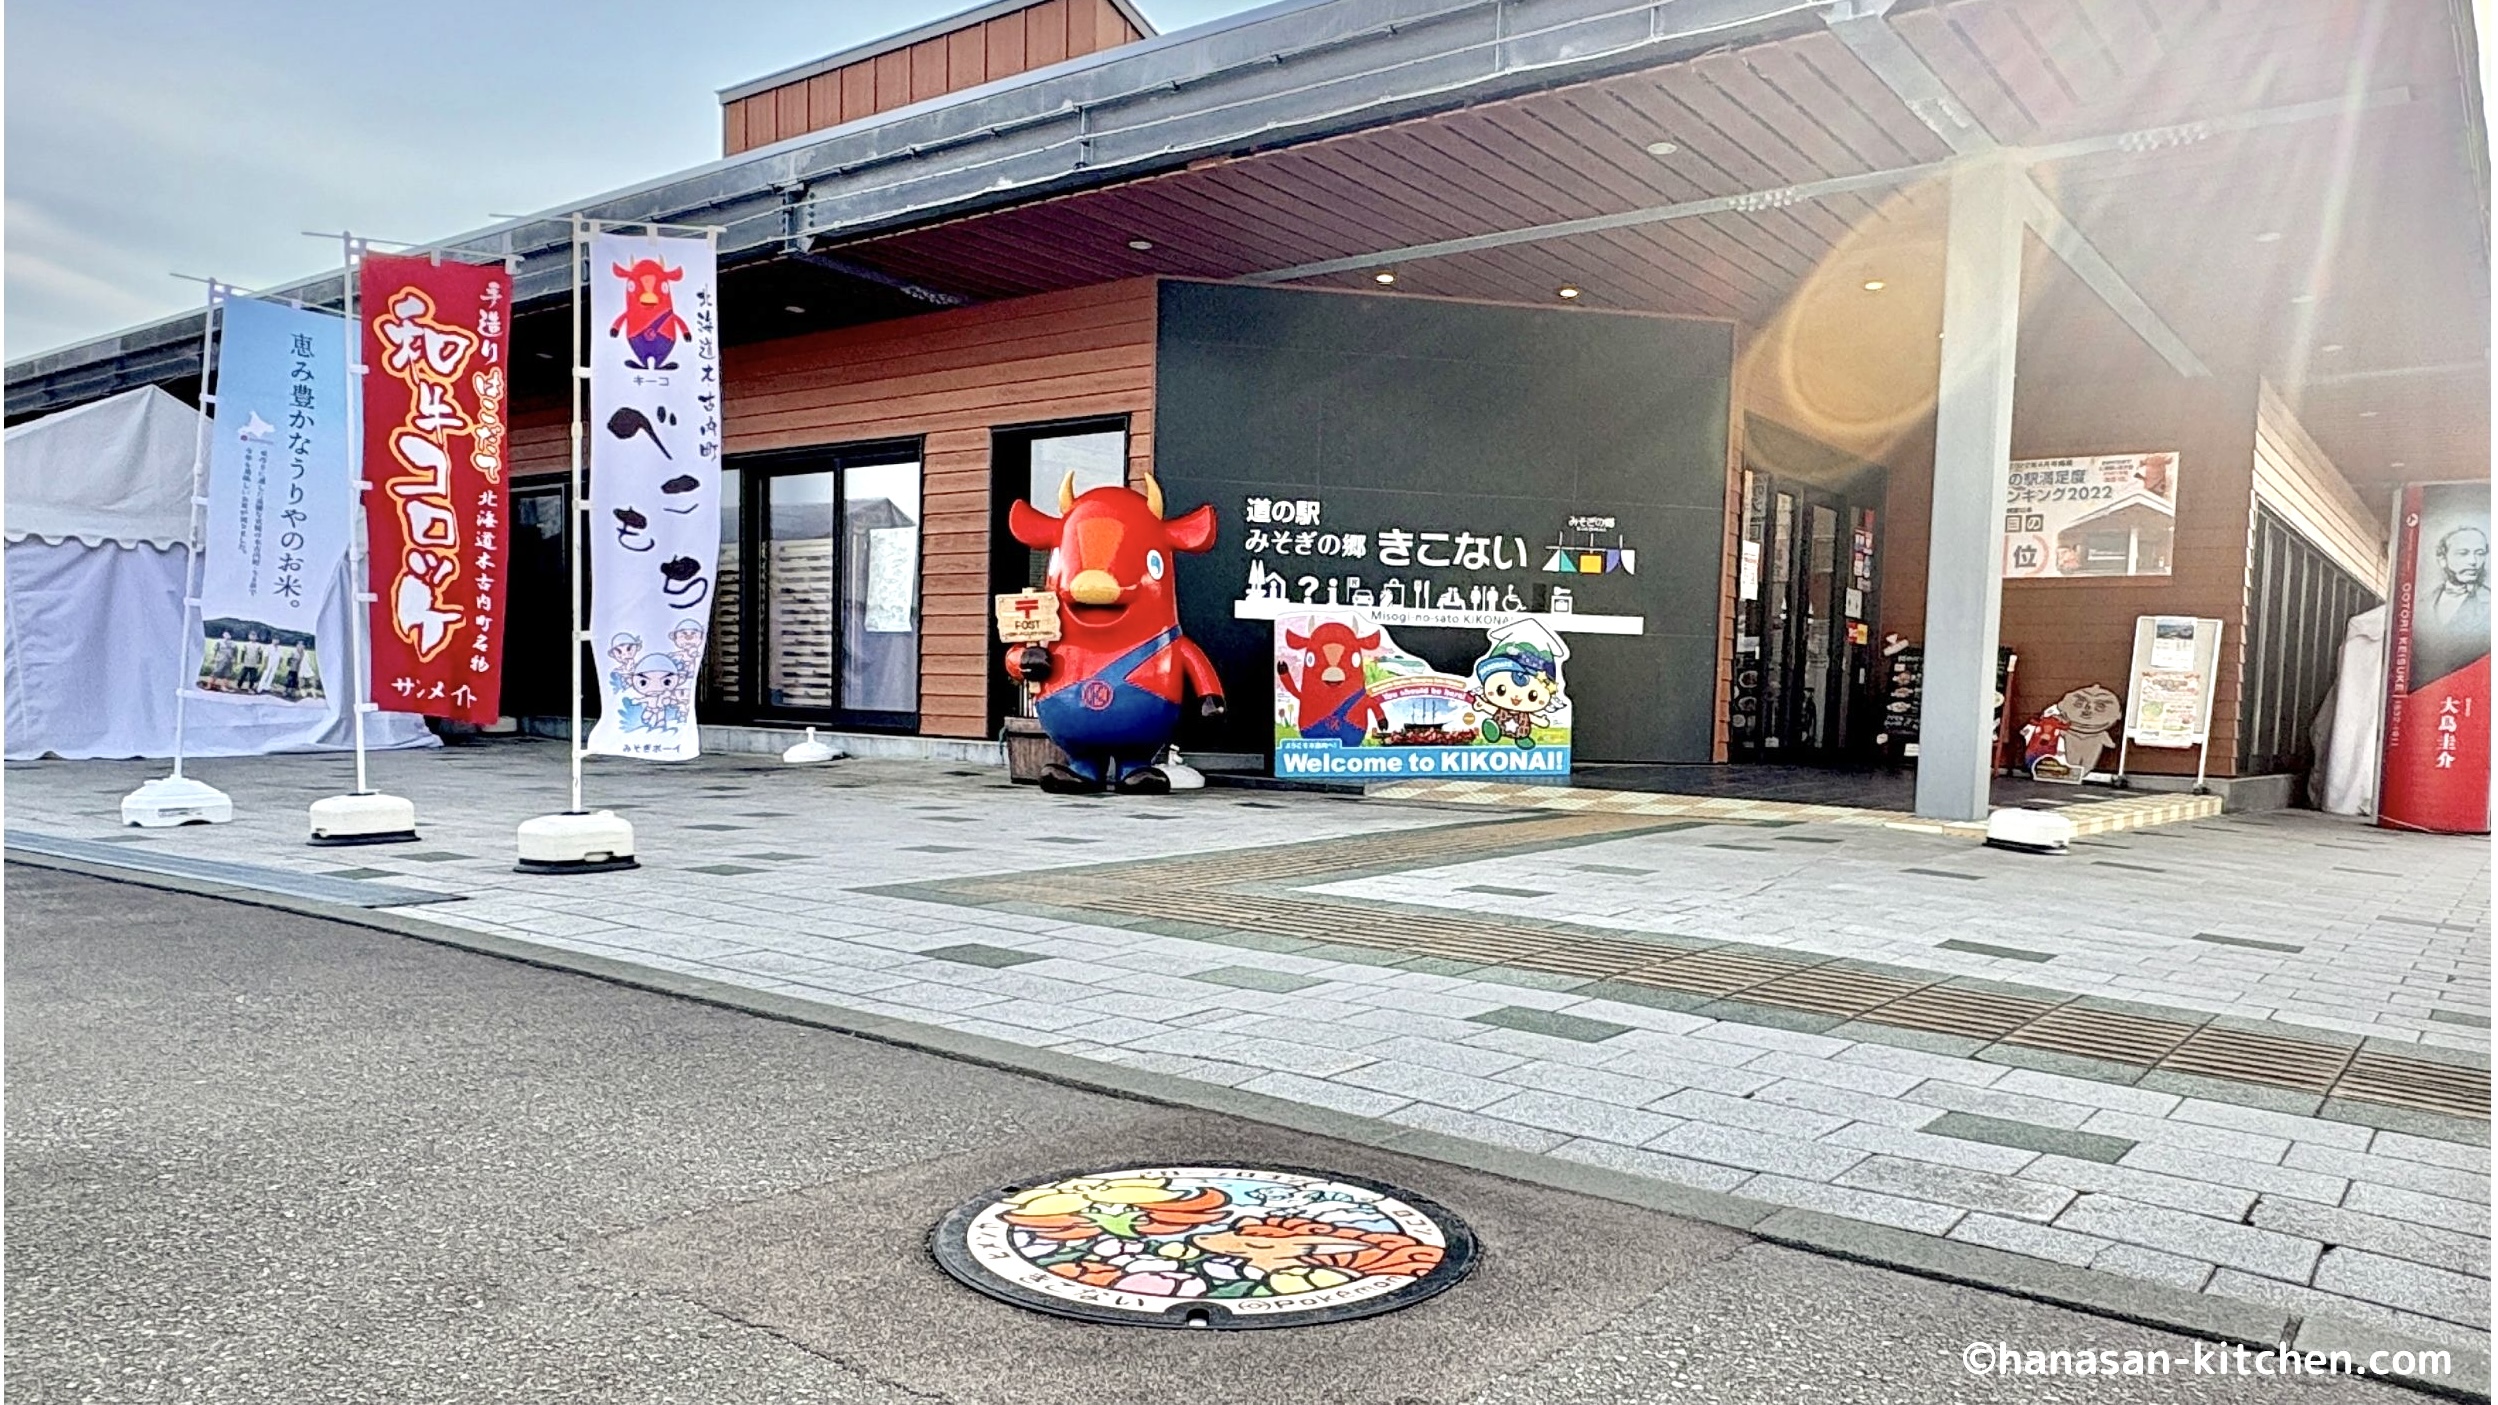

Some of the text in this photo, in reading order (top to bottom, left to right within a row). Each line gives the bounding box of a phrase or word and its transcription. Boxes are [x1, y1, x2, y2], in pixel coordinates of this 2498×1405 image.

[632, 374, 670, 387] キーコ
[696, 283, 719, 462] 北海道木古内町
[273, 333, 315, 609] 恵み豊かなうりやのお米。
[374, 287, 478, 663] 和牛コロッケ
[469, 281, 505, 674] 手造り はこだて 北海道木古内町名物
[607, 405, 709, 610] べこもち
[1246, 498, 1321, 526] 道の駅
[1245, 528, 1528, 570] みそぎの郷 きこない
[1014, 619, 1041, 630] POST
[1371, 610, 1513, 625] Misogi-no-sato KIKONA
[2400, 583, 2412, 632] OOTORI
[2395, 636, 2408, 692] KEISUKE
[391, 676, 478, 709] サンメイト
[622, 743, 682, 754] みそぎボーイ
[1283, 752, 1564, 773] Welcome to KIKONAI!
[1392, 1209, 1433, 1237] ロコン
[1018, 1270, 1145, 1308] きこない
